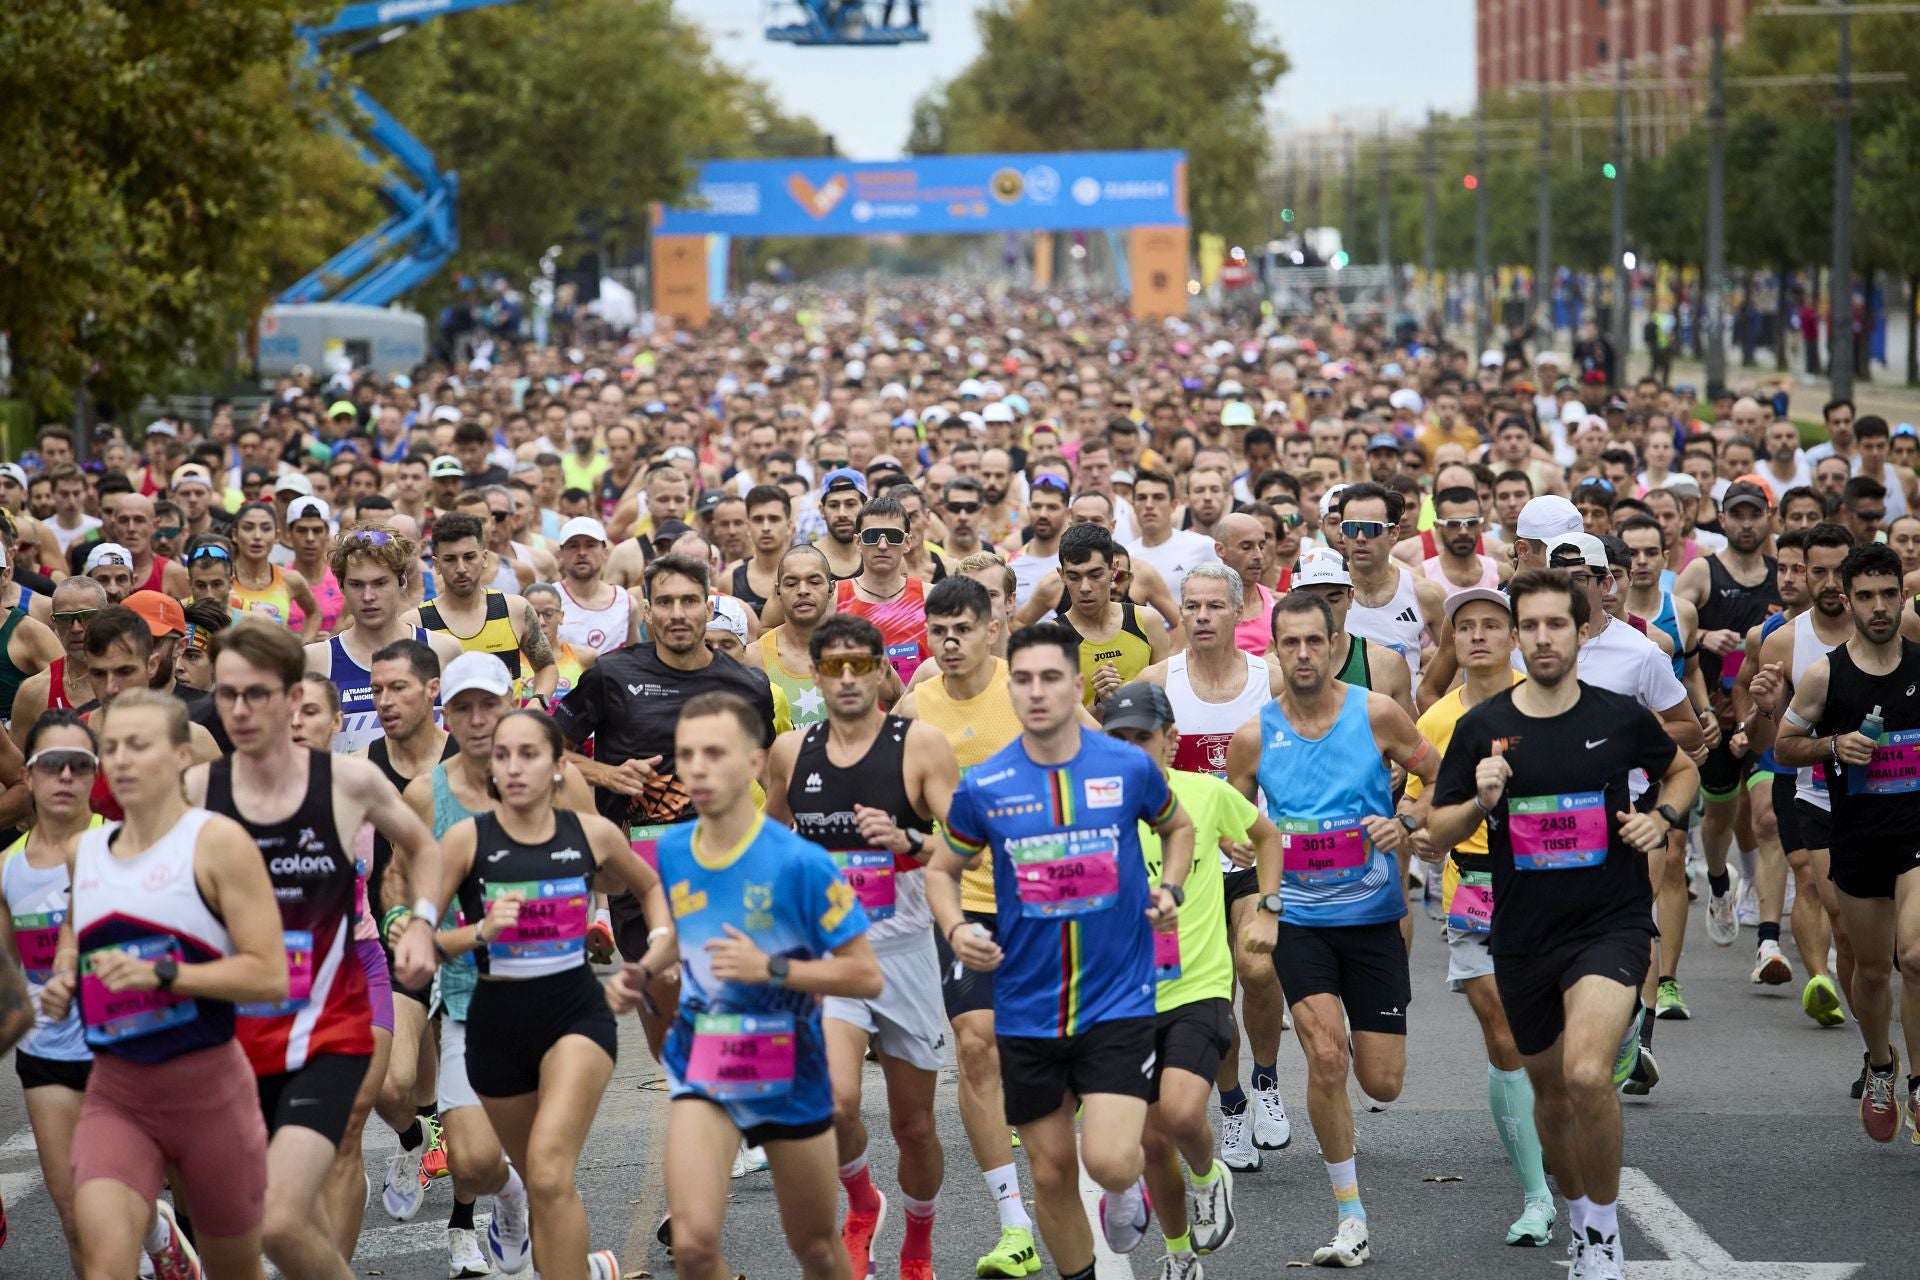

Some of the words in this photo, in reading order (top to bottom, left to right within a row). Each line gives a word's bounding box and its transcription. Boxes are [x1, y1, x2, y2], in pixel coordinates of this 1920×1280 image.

[1872, 750, 1904, 762] 3414
[1866, 766, 1917, 779] ABALLERO
[1575, 797, 1599, 806] ZURICH
[1333, 818, 1355, 827] ZURICH
[1541, 816, 1577, 832] 2438
[1302, 837, 1336, 852] 3013
[1542, 837, 1579, 851] TUSET
[1047, 862, 1085, 879] 2250
[1308, 858, 1335, 870] Agus
[520, 903, 556, 918] 2647
